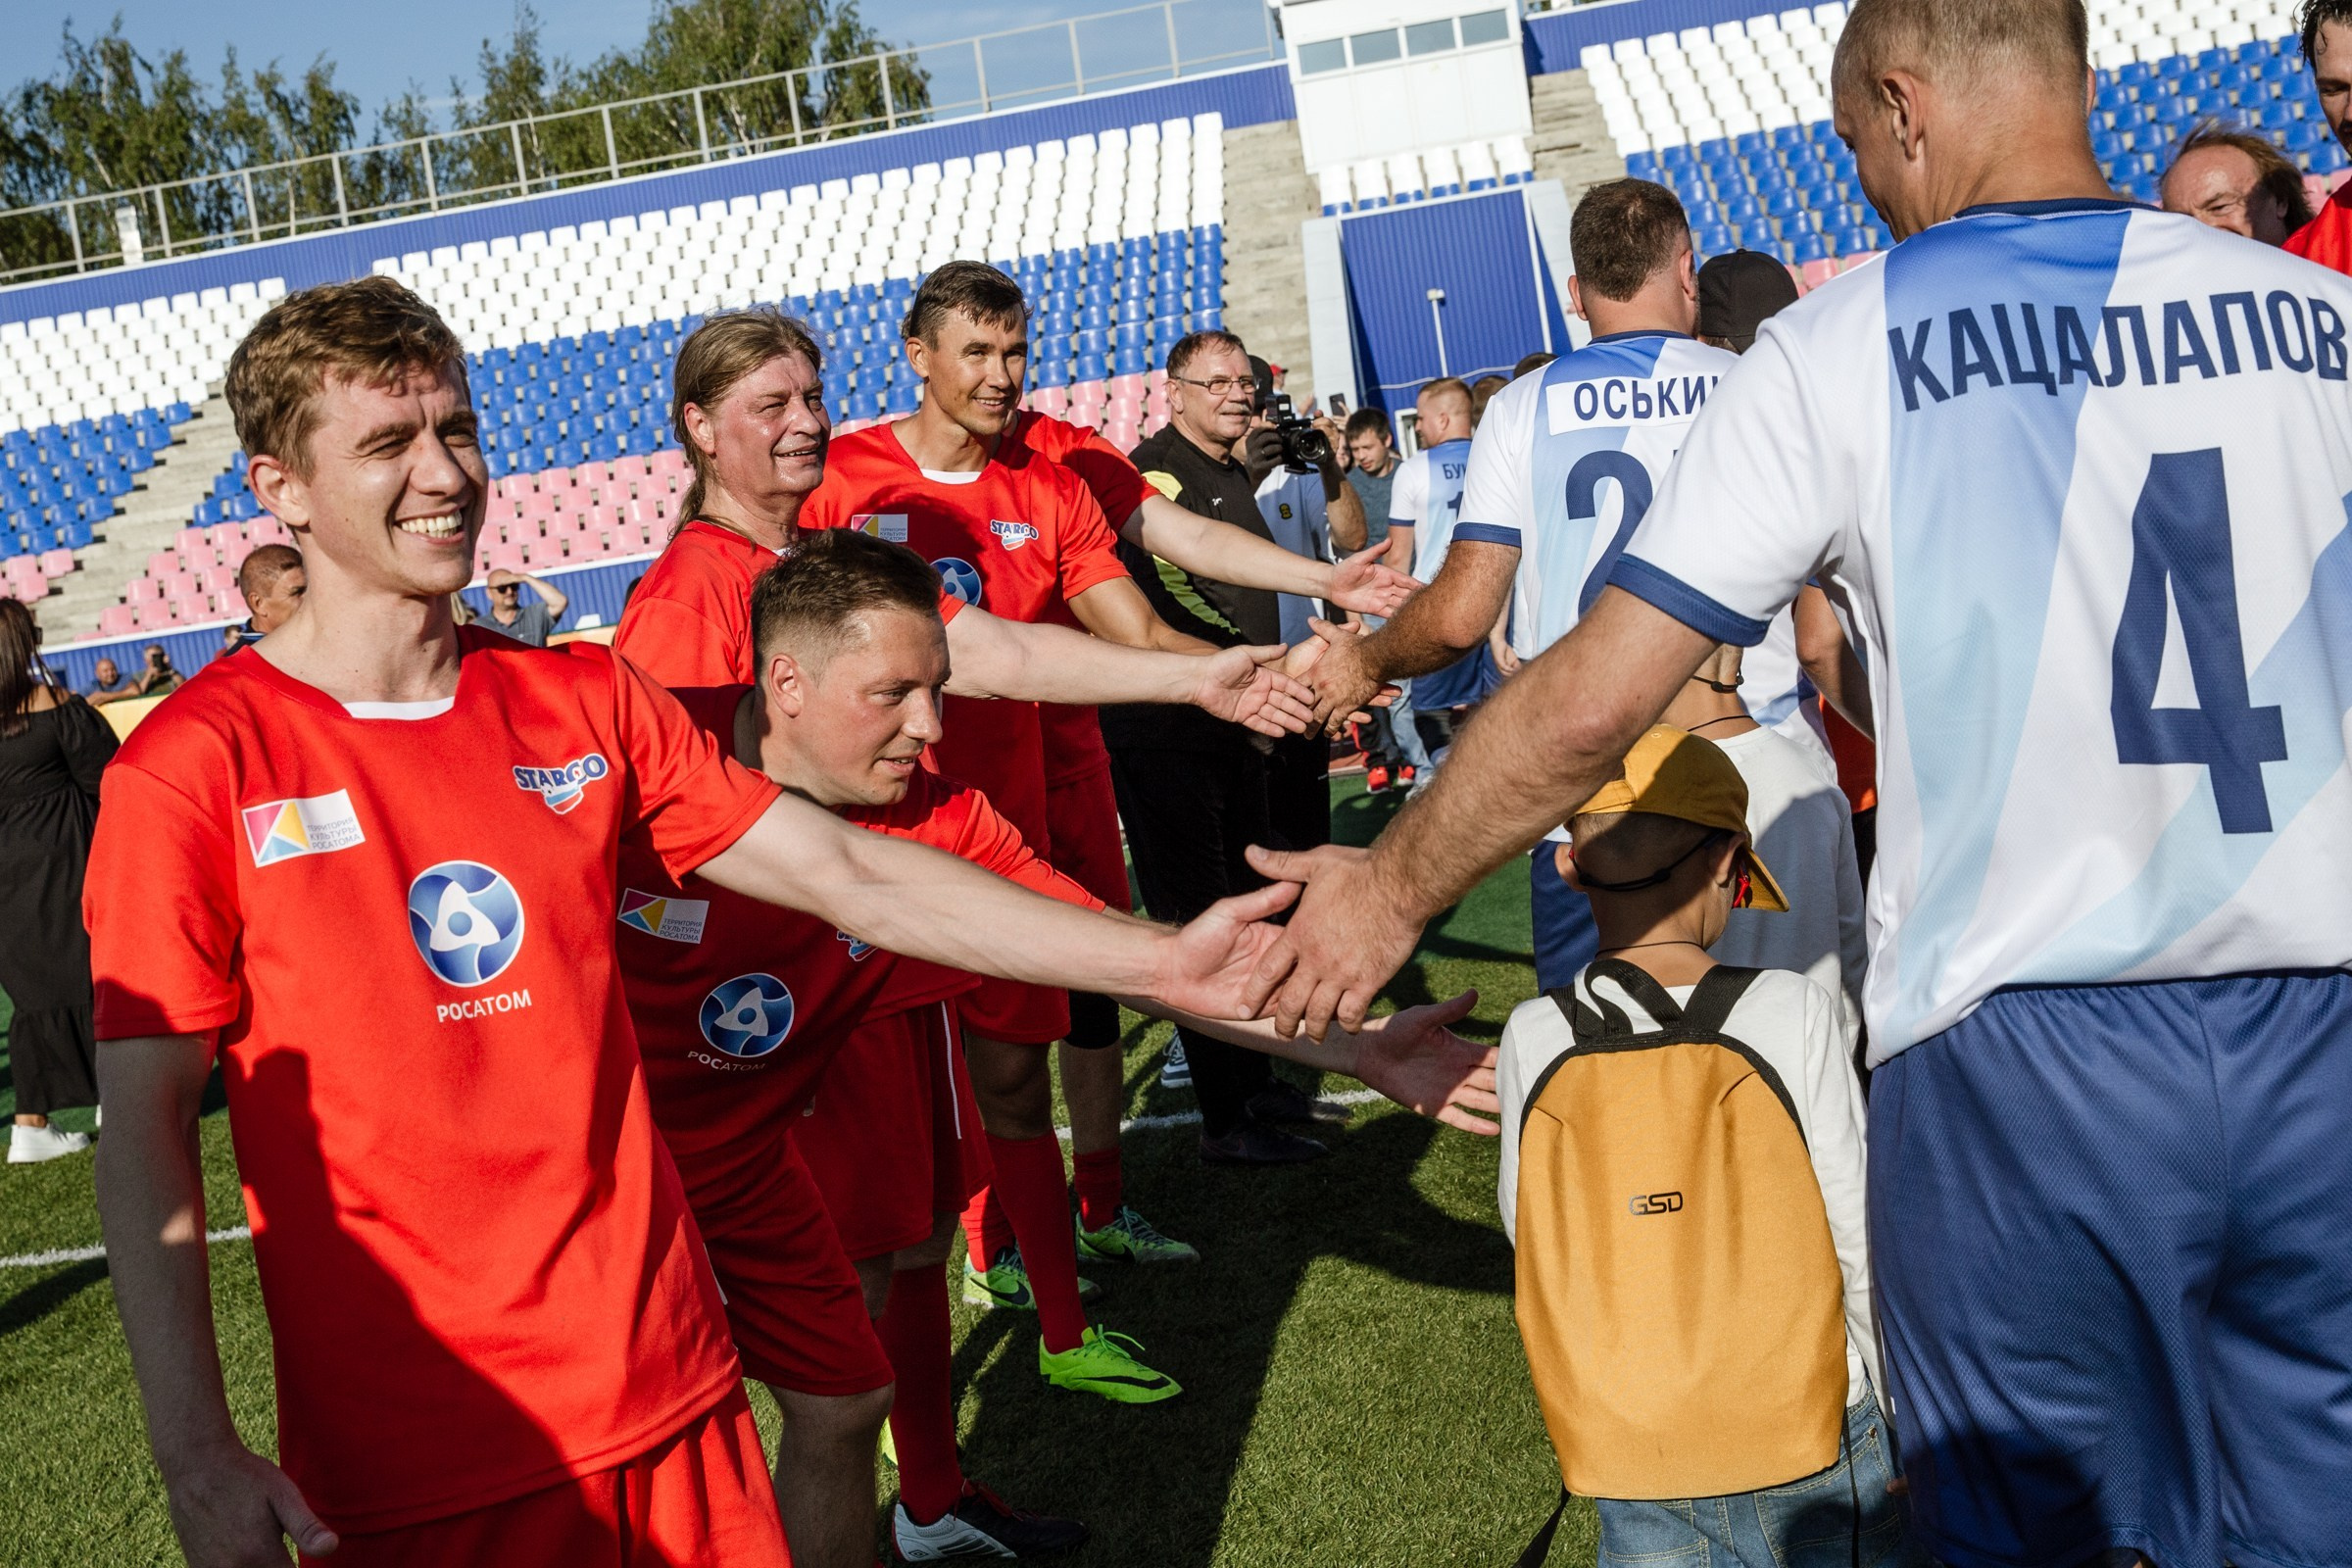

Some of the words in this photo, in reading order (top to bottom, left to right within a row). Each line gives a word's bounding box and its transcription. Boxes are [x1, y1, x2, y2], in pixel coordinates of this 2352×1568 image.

[1887, 290, 2348, 413] КАЦАЛАПОВ
[1574, 376, 1719, 421] ОСЬКИ
[2110, 447, 2288, 834] 4
[514, 754, 607, 790] STARCO
[307, 816, 354, 832] ТЕРРИТОРИЯ
[310, 824, 357, 841] КУЛЬТУРЫ
[312, 833, 361, 850] РОСАТОМА
[661, 924, 701, 935] КУЛЬТУРЫ
[663, 918, 703, 928] ТЕРРИТОРИЯ
[659, 929, 699, 942] РОСАТОМА
[436, 989, 532, 1023] РОСАТОМ
[687, 1051, 765, 1072] РОСАТОМ
[1629, 1191, 1684, 1215] GSD
